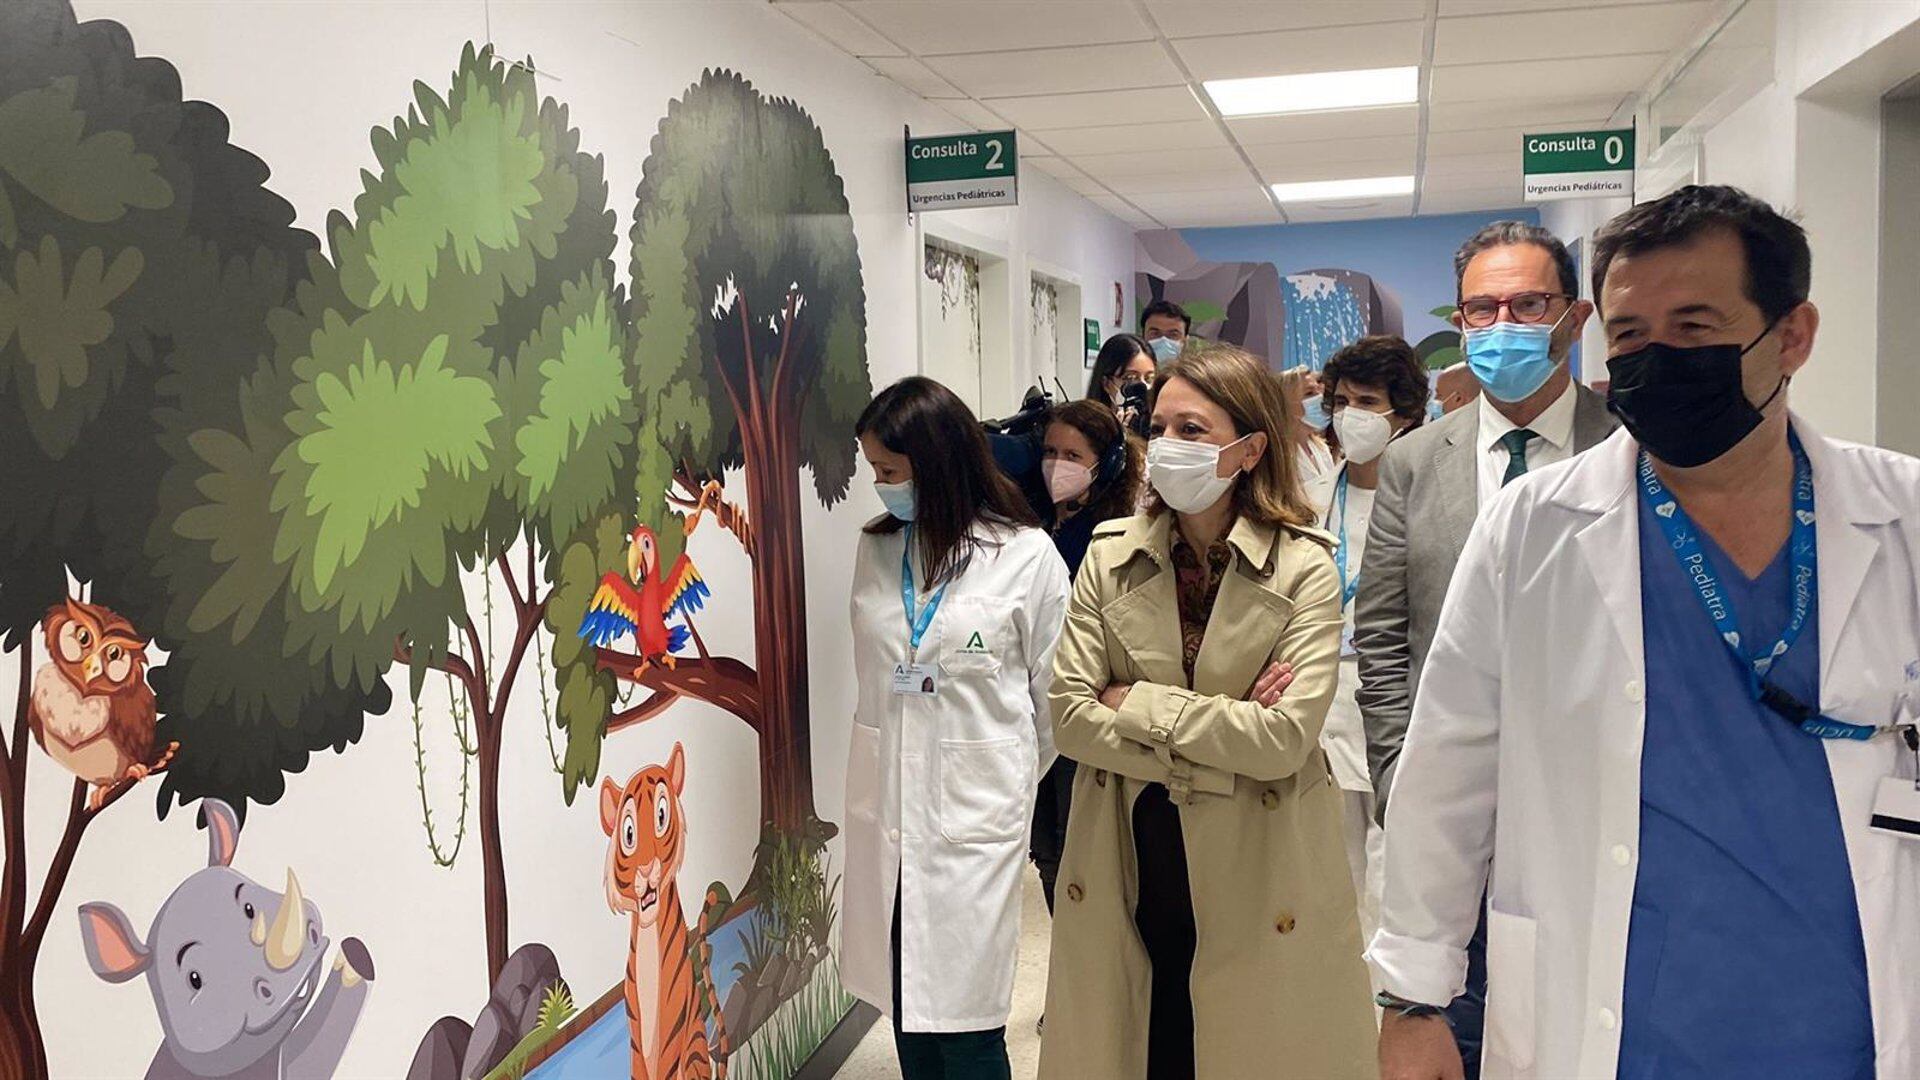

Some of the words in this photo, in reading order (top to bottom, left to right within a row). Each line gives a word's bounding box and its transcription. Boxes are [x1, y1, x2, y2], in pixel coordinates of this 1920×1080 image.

[911, 140, 977, 159] Consulta
[985, 139, 1004, 170] 2
[1528, 137, 1596, 153] Consulta
[1604, 136, 1624, 165] 0
[912, 192, 955, 204] Urgencias
[957, 188, 1005, 200] Pediátricas
[1527, 183, 1571, 194] Urgencias
[1572, 180, 1622, 191] Pediátricas
[1685, 552, 1727, 622] Pediatra
[1791, 564, 1813, 631] Pediatra
